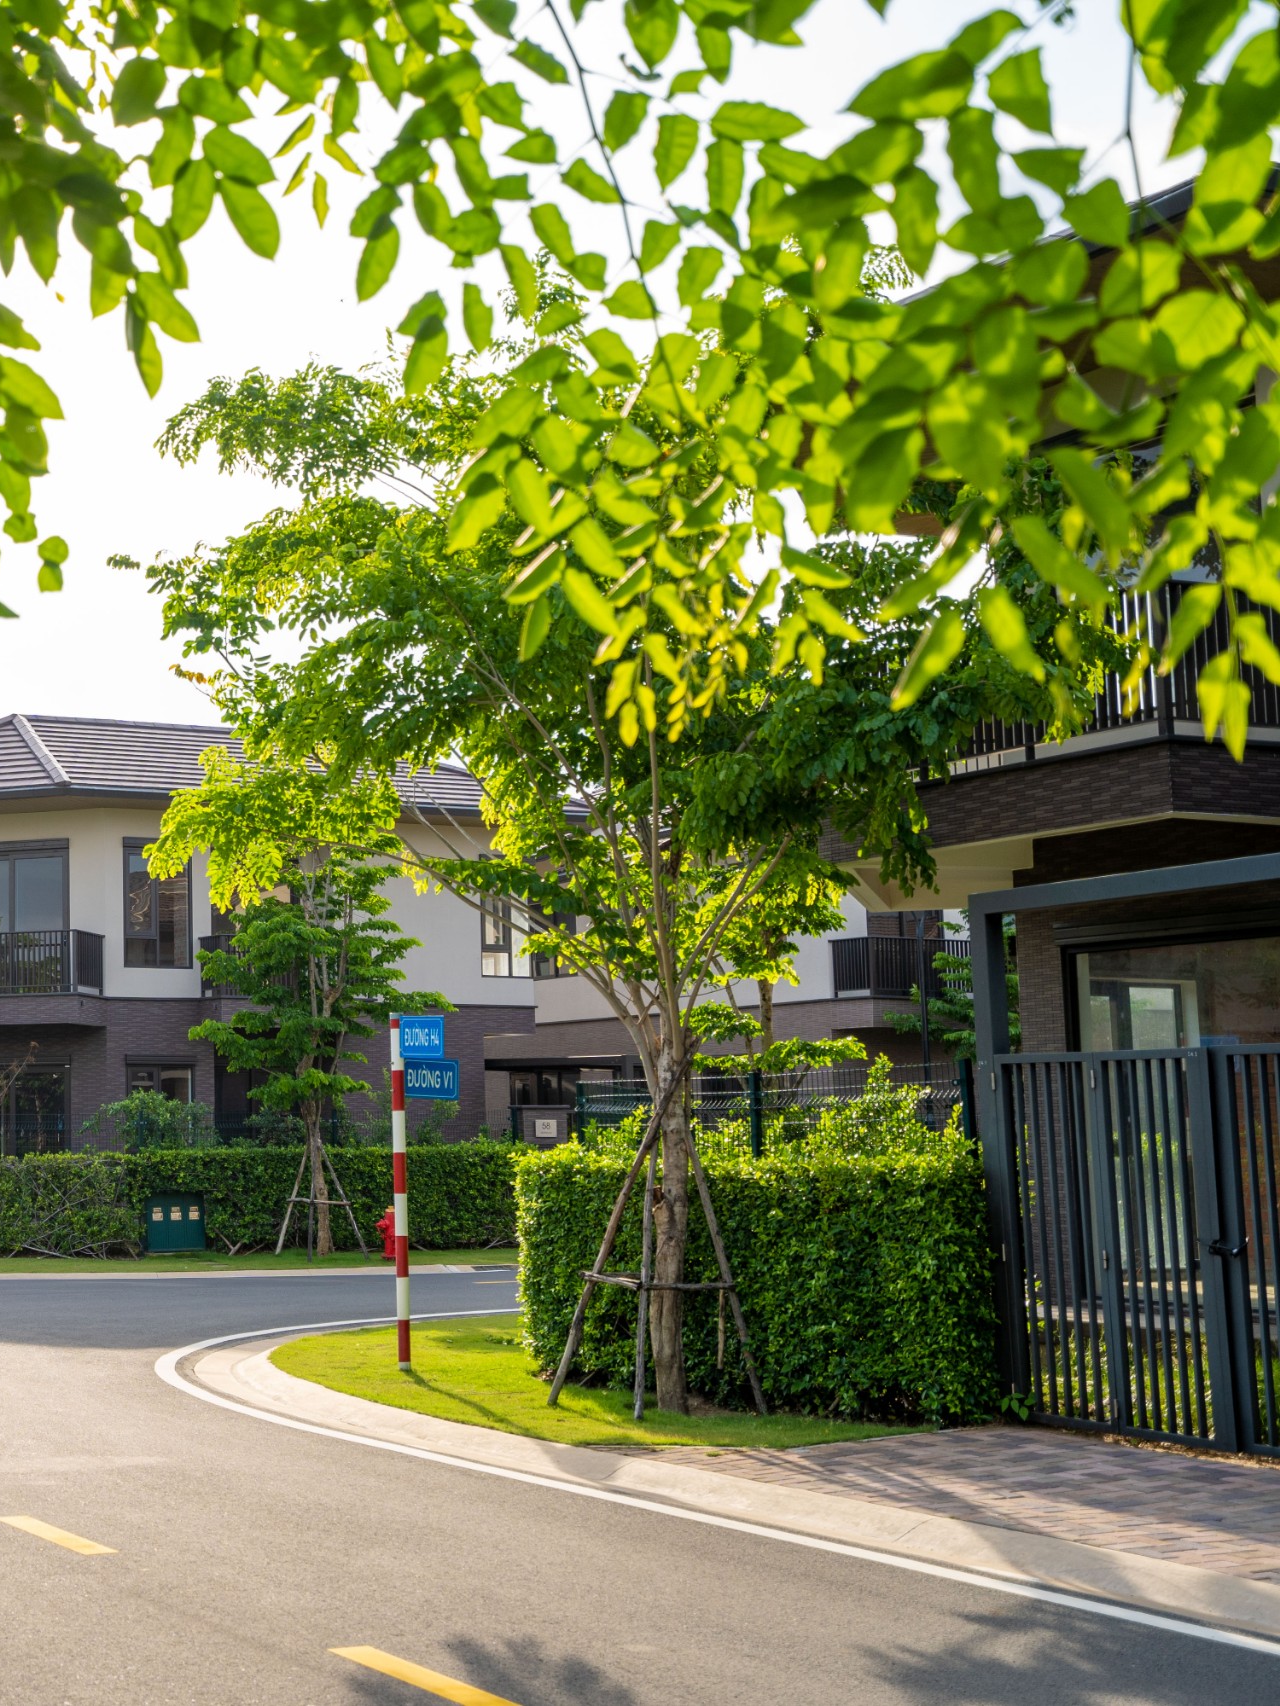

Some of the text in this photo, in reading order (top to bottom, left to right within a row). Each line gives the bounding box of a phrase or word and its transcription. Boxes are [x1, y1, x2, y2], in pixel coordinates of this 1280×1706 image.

[404, 1023, 439, 1047] ĐƯỜNG H4
[407, 1065, 453, 1089] ĐƯỜNG V1
[541, 1121, 551, 1130] 58
